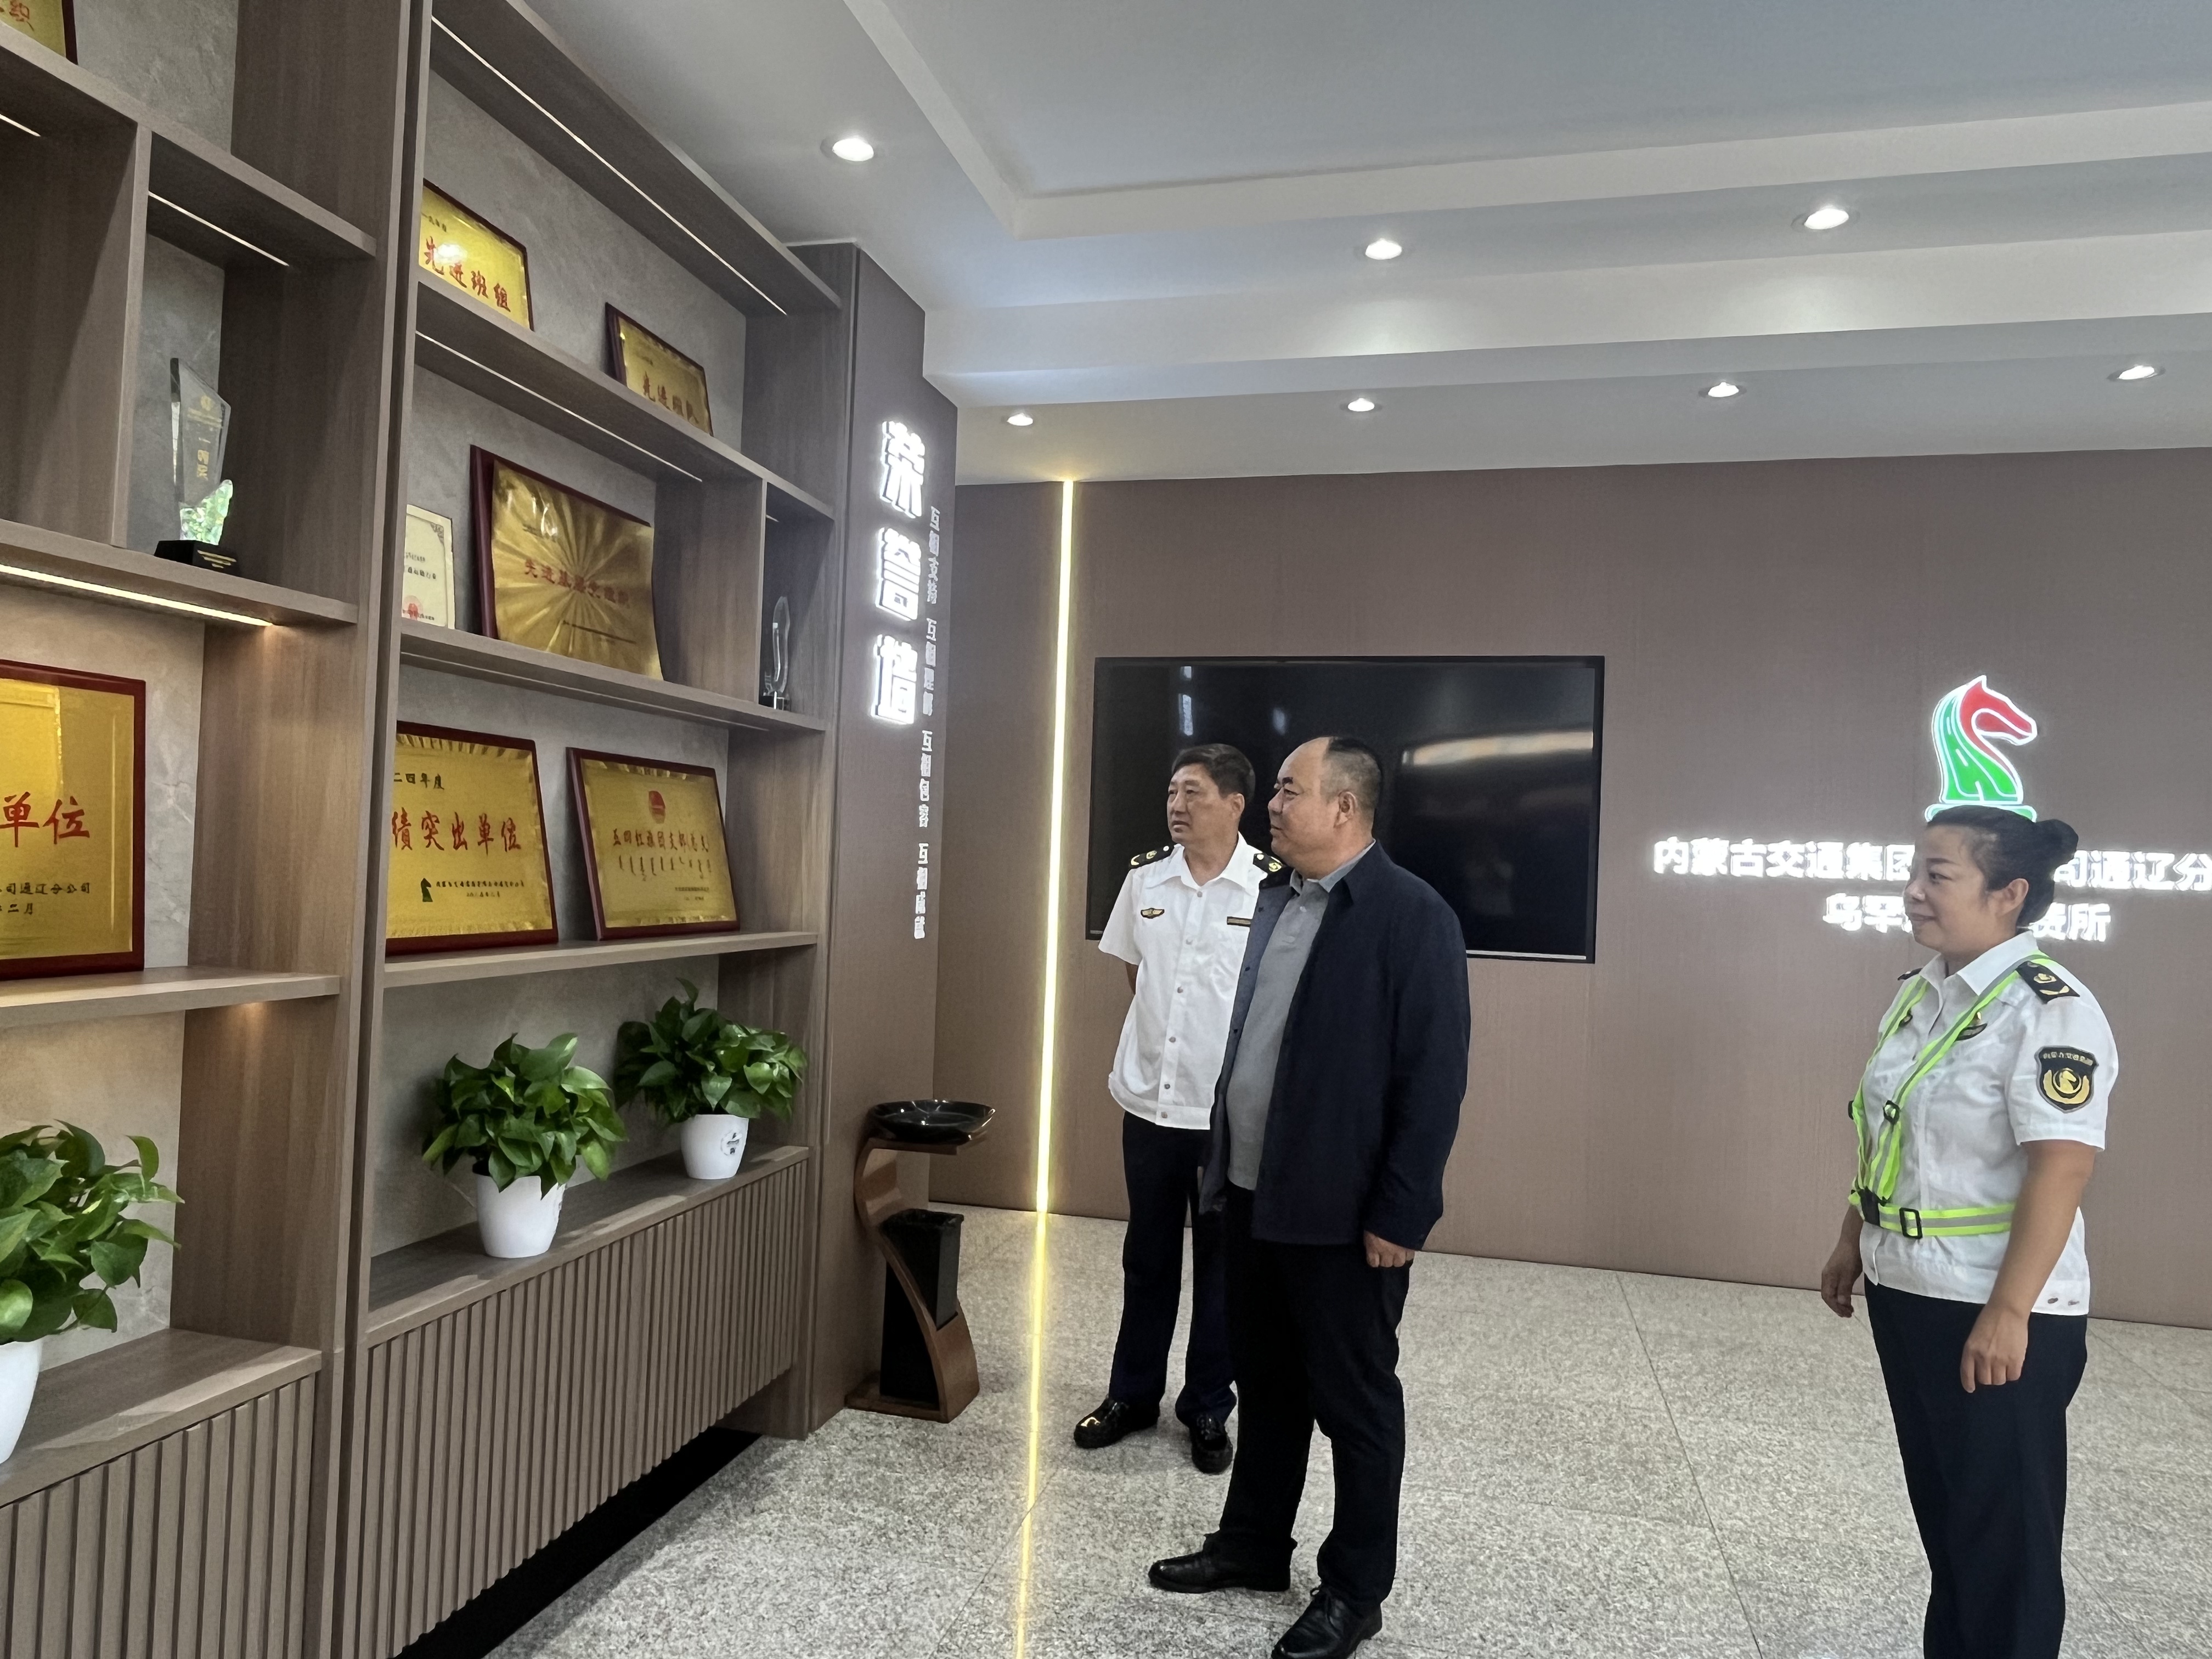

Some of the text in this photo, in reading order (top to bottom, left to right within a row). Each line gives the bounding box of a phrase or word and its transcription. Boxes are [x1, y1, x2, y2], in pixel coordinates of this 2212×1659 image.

[873, 421, 926, 725] 荣誉墙
[0, 791, 90, 847] 单位
[391, 806, 522, 856] 绩突出单位
[0, 882, 90, 895] 司通辽分公司
[0, 903, 33, 915] 二月
